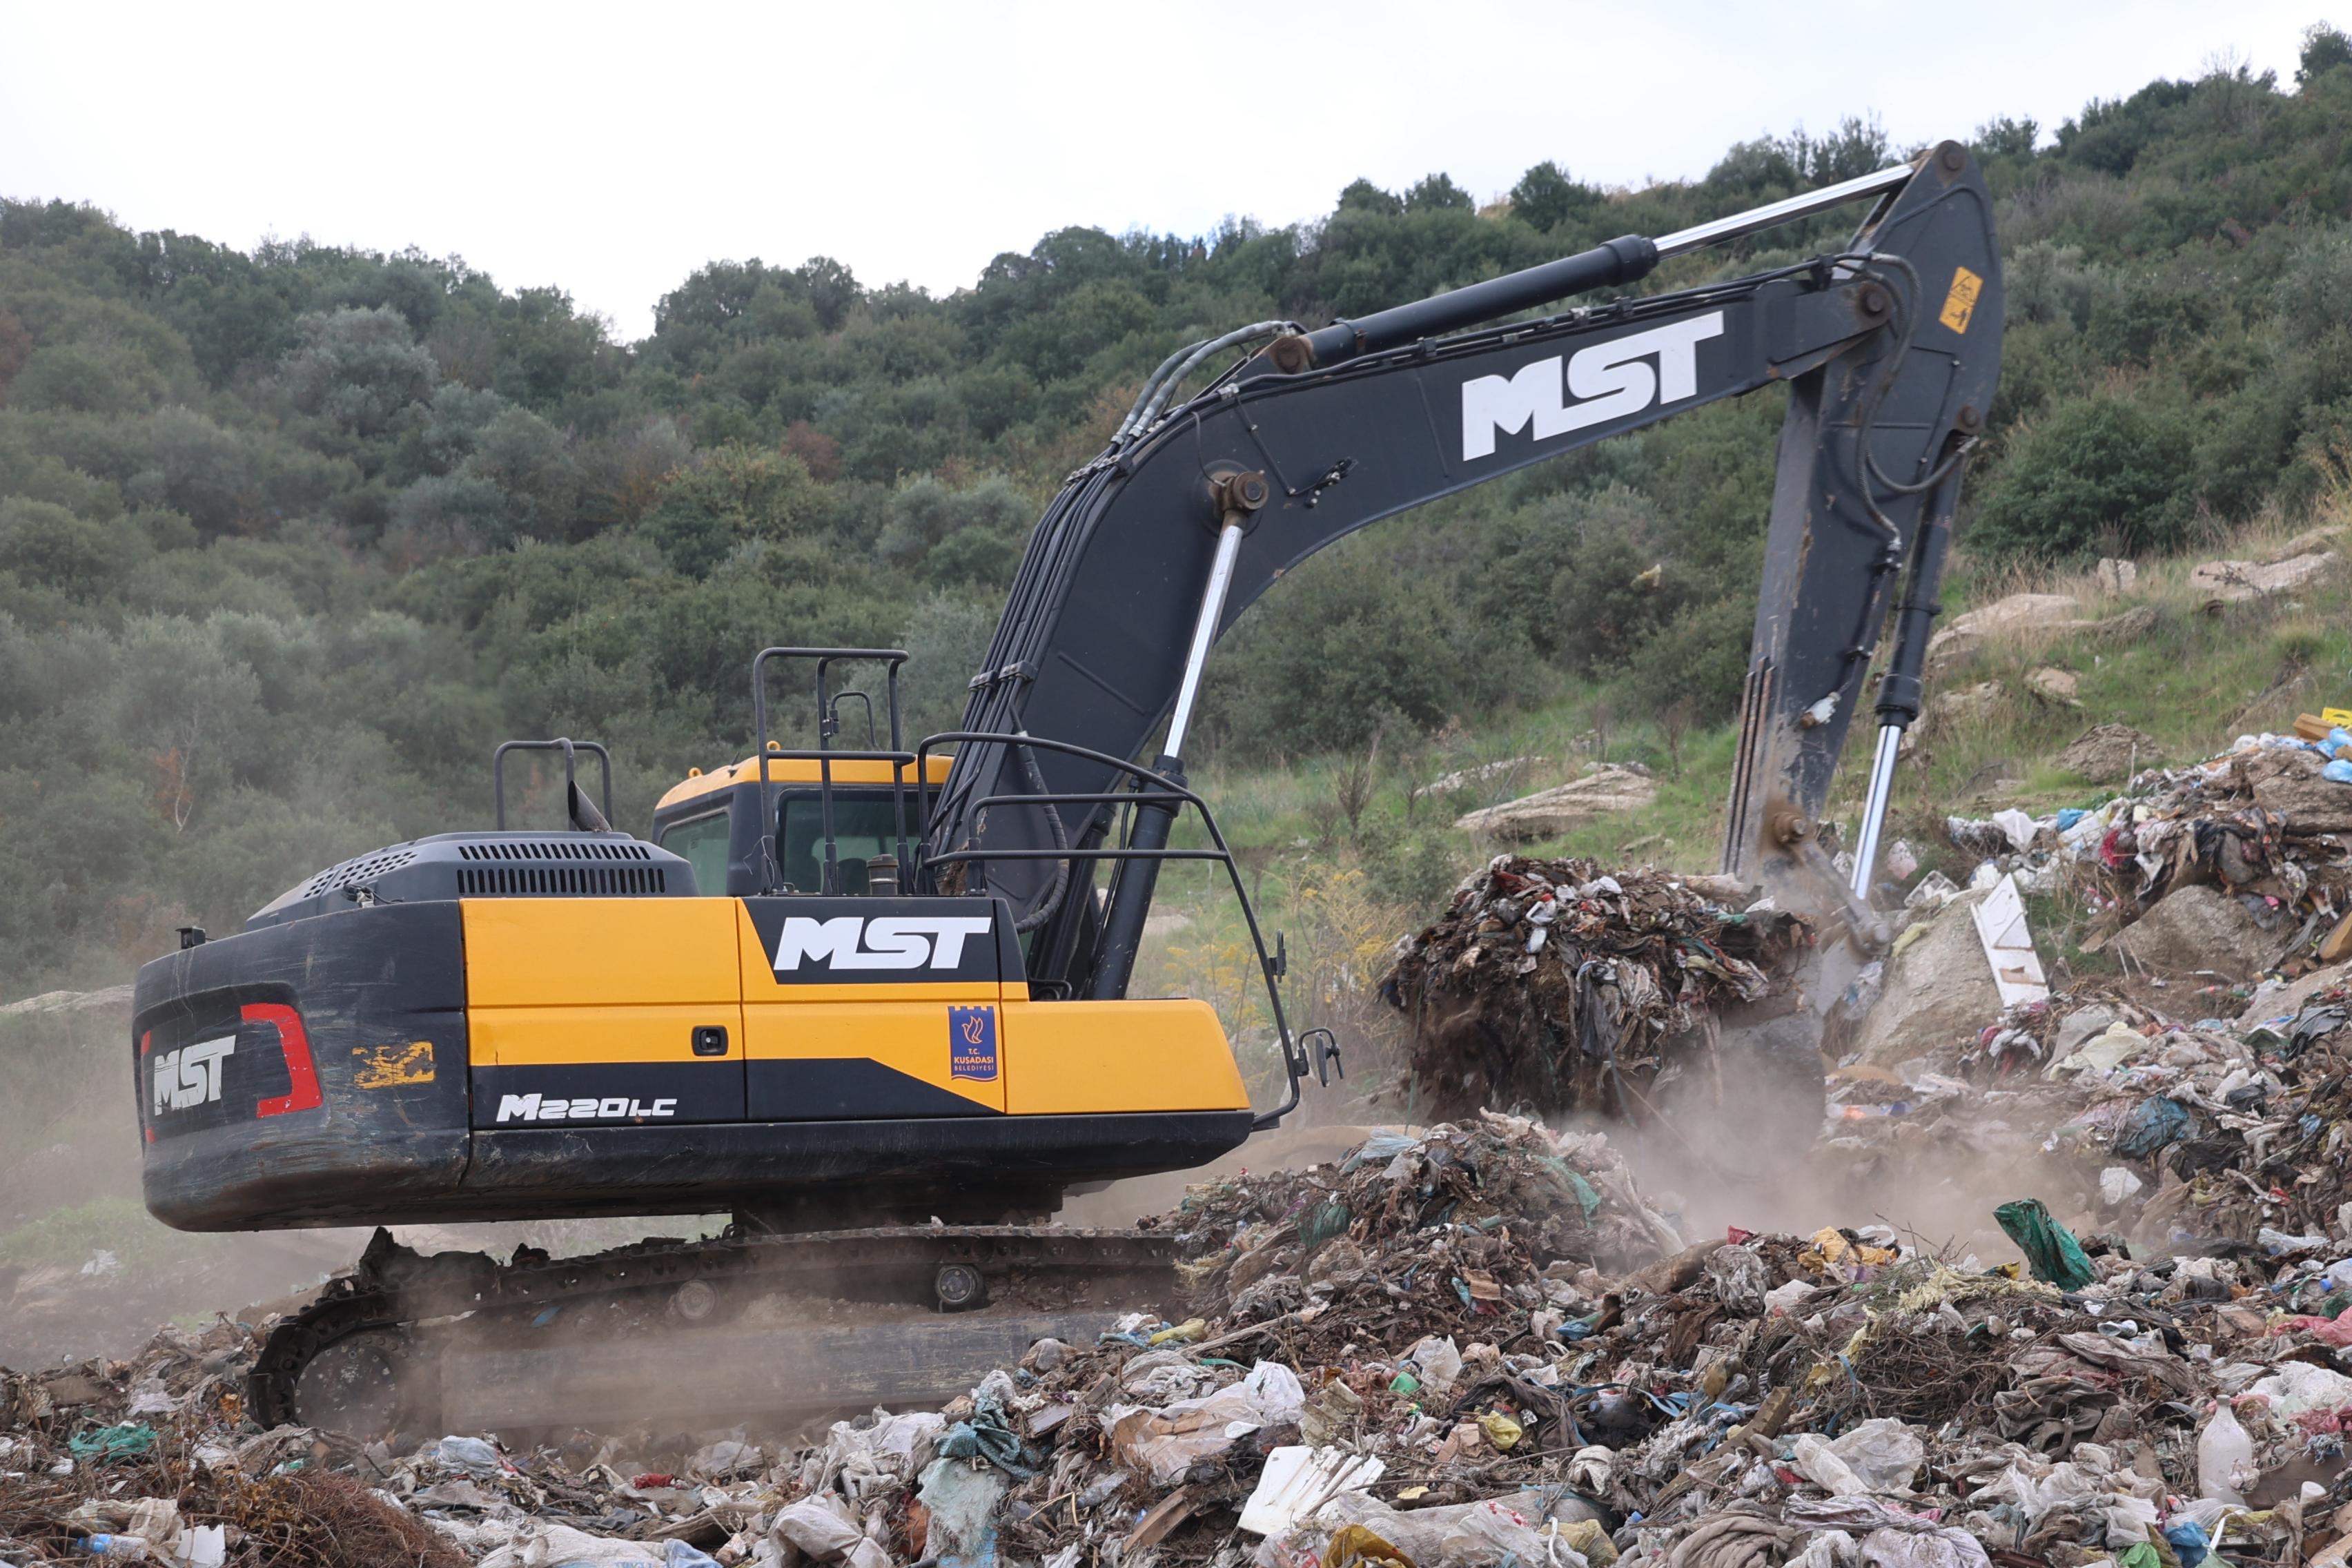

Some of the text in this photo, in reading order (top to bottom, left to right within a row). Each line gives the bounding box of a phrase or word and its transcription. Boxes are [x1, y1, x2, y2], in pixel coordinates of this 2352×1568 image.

[1462, 311, 1725, 462] MST
[773, 917, 992, 971] MST
[153, 1035, 237, 1116] MST
[496, 1093, 678, 1122] M220LC
